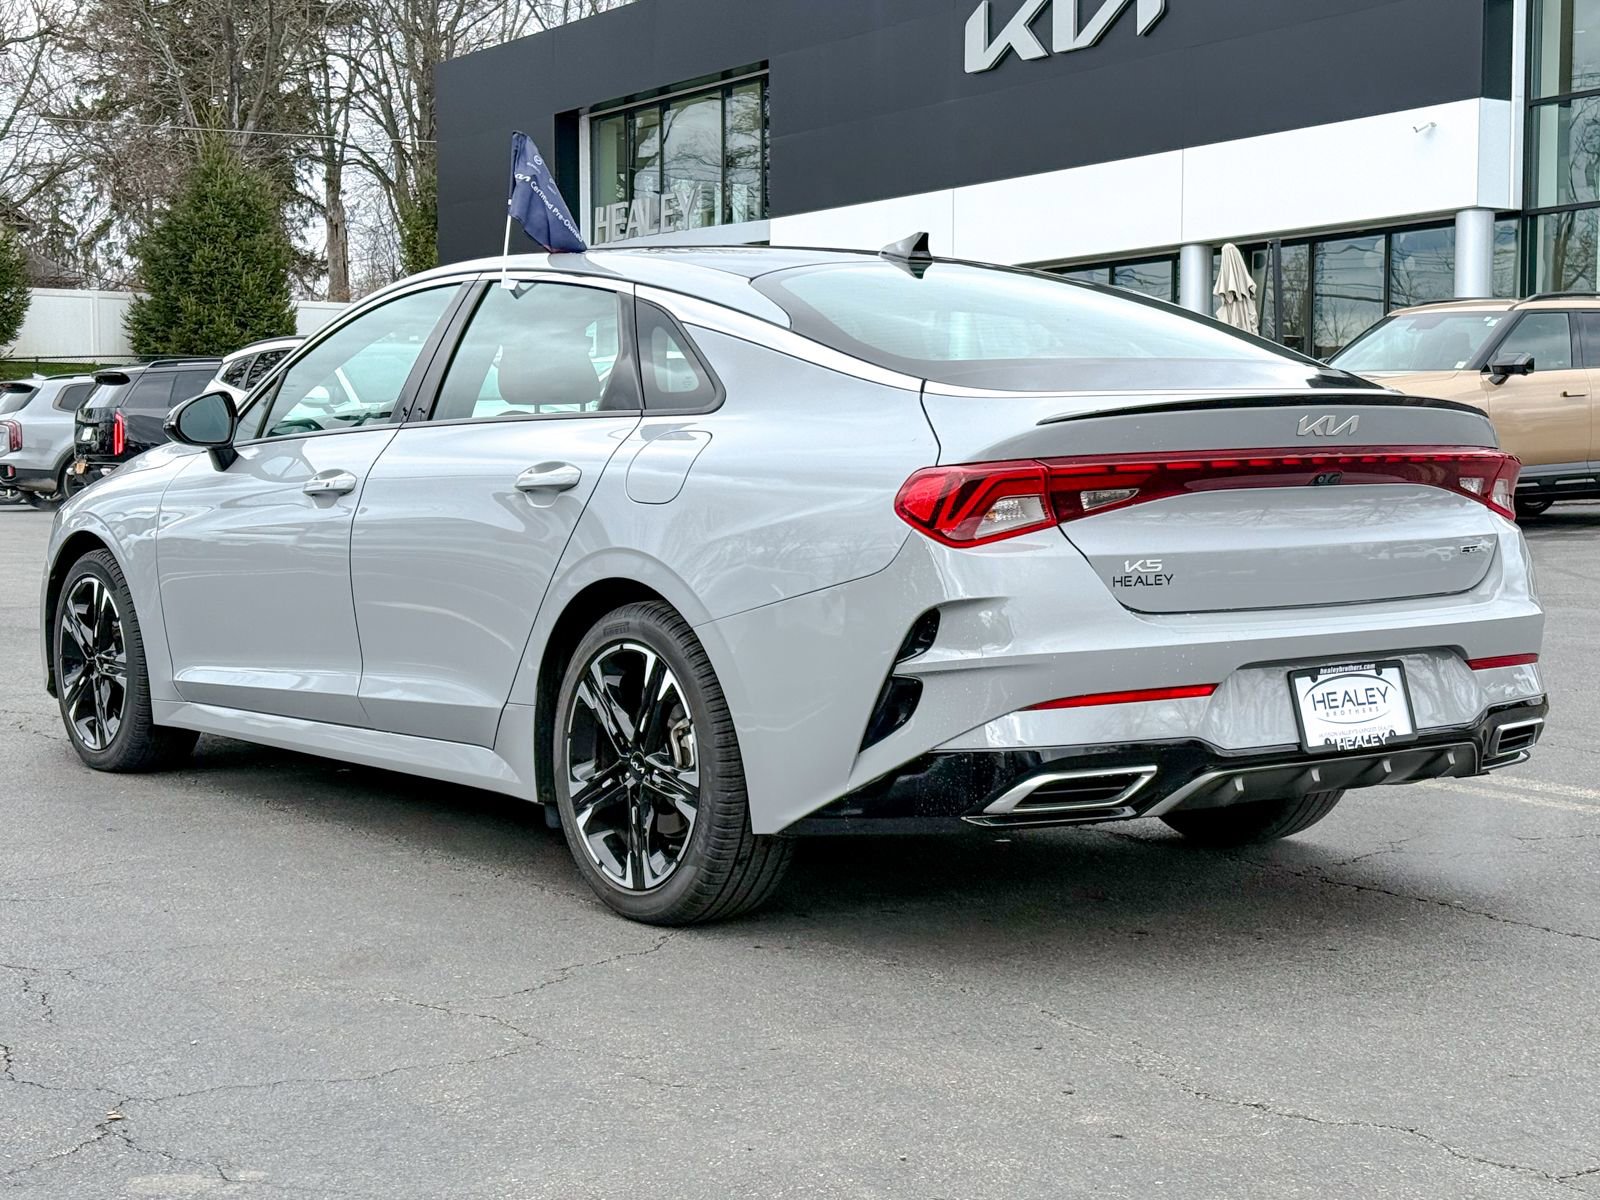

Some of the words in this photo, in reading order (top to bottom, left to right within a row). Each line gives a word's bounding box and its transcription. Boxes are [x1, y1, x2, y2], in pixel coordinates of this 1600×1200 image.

[594, 183, 702, 245] HEALEY
[1296, 414, 1360, 437] KIA
[1124, 559, 1163, 573] K5
[1112, 573, 1174, 588] HEALEY
[1320, 663, 1376, 675] healeybrothers.com
[1312, 686, 1388, 711] HEALEY
[1326, 706, 1379, 717] BROTHERS
[1335, 732, 1387, 751] HEALEY
